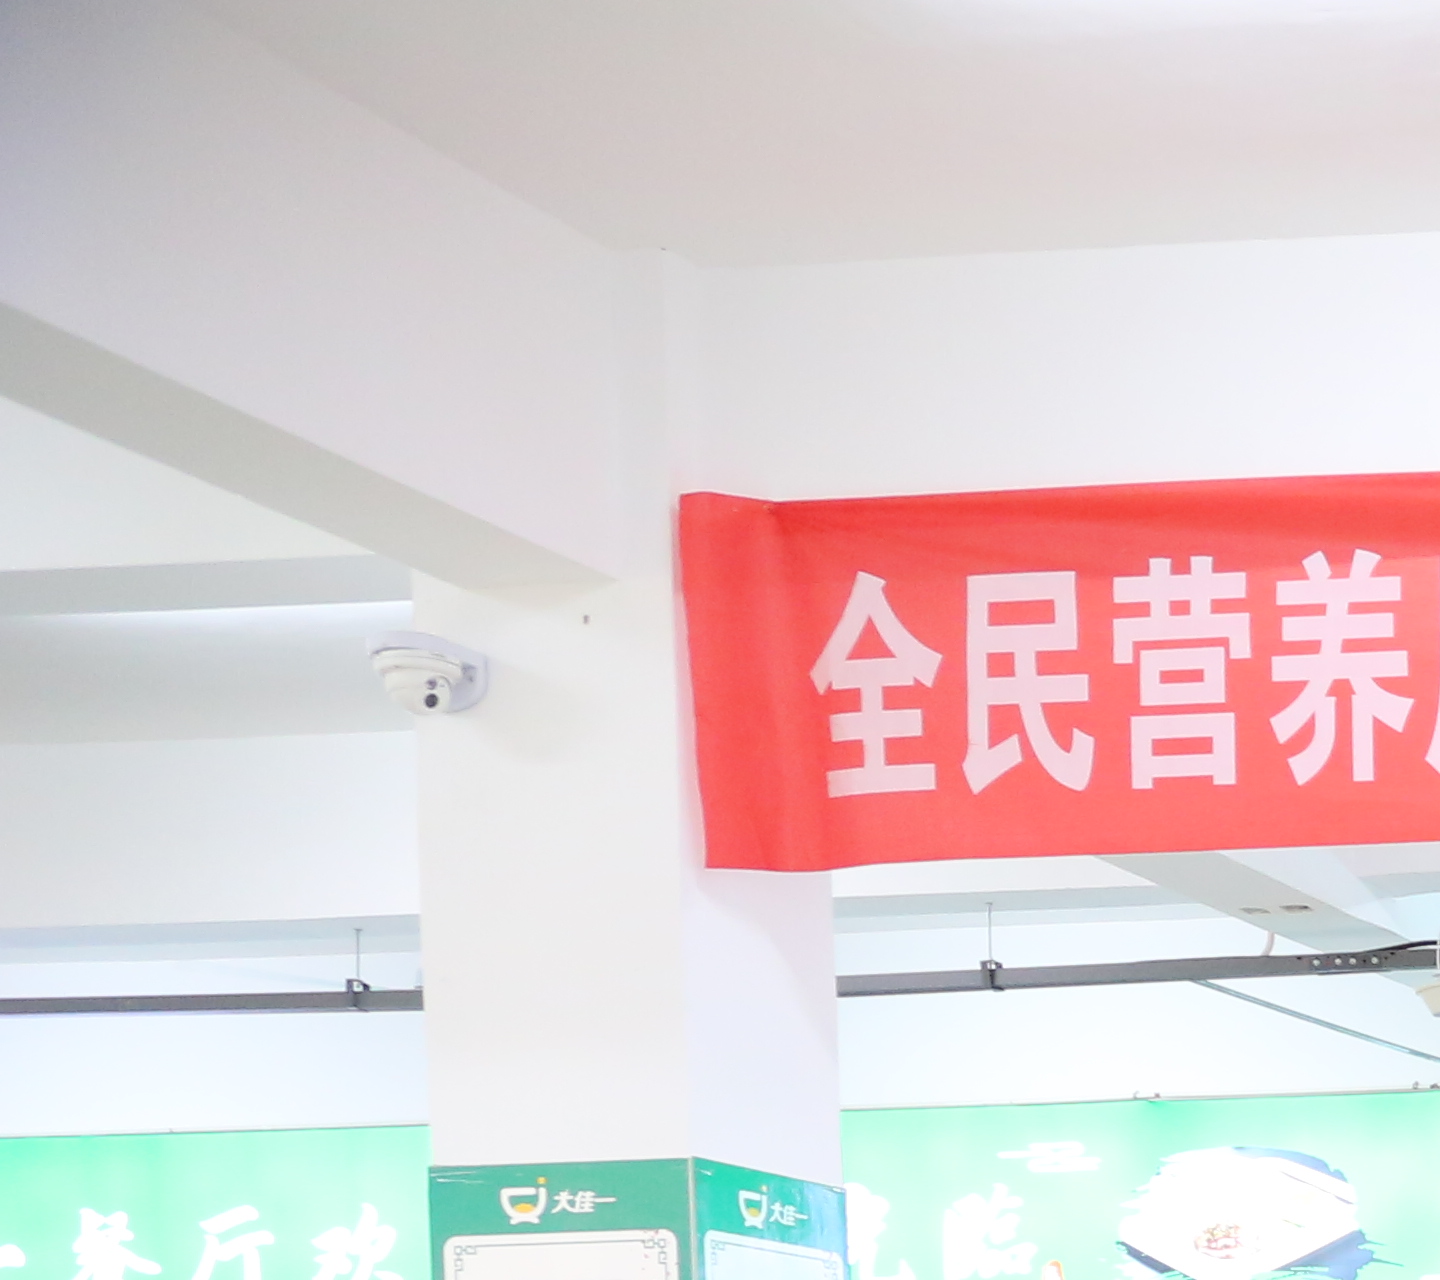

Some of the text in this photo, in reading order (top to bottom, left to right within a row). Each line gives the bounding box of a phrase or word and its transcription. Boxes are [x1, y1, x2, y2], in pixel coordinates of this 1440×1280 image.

[551, 1190, 617, 1213] 大佳一
[769, 1202, 808, 1225] 大佳一
